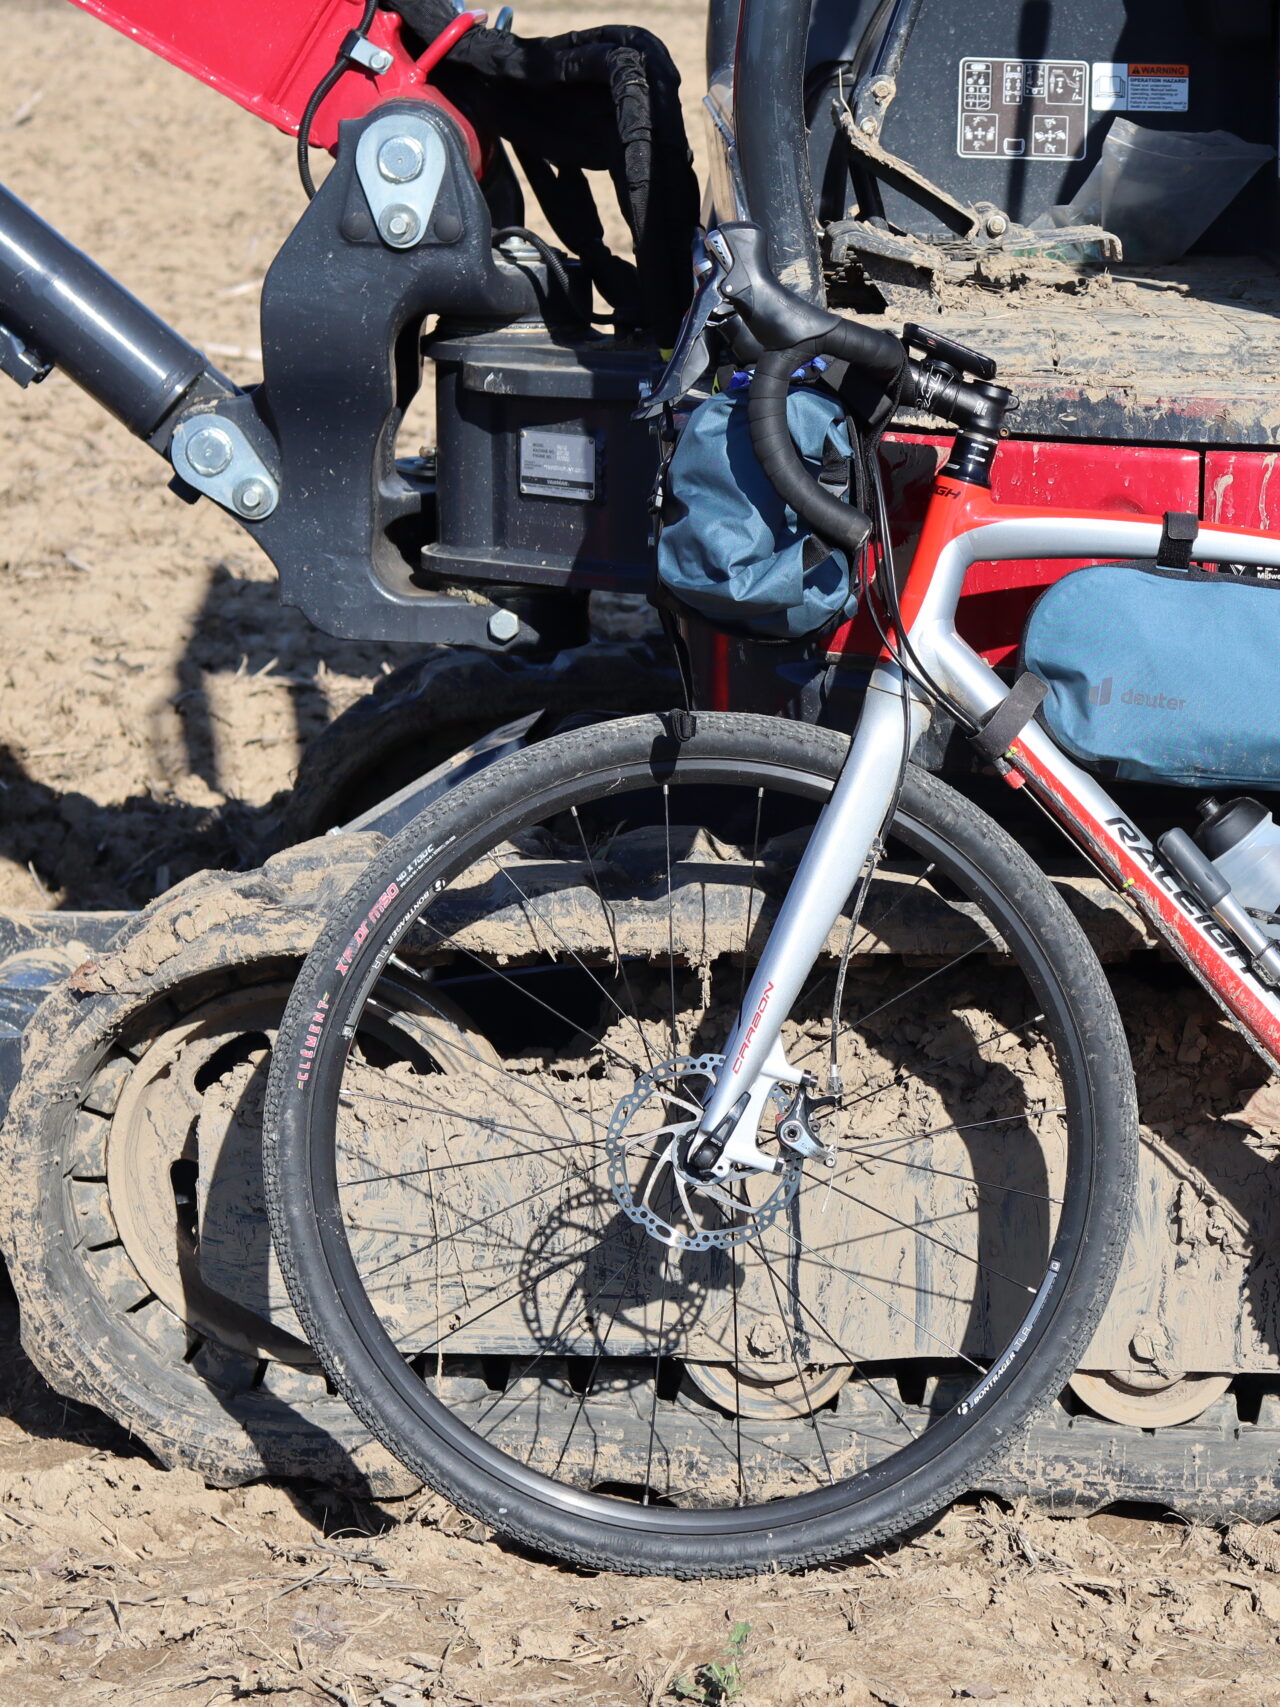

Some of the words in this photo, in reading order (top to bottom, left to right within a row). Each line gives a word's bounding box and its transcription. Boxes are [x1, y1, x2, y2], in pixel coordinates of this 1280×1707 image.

[1141, 66, 1184, 75] WARNING
[1120, 688, 1187, 711] deuter
[387, 890, 430, 945] BONTRAGER
[370, 947, 390, 970] TLR
[732, 981, 775, 1076] CARBON
[972, 1351, 1016, 1405] BONTRAGER
[1013, 1326, 1031, 1352] TLR
